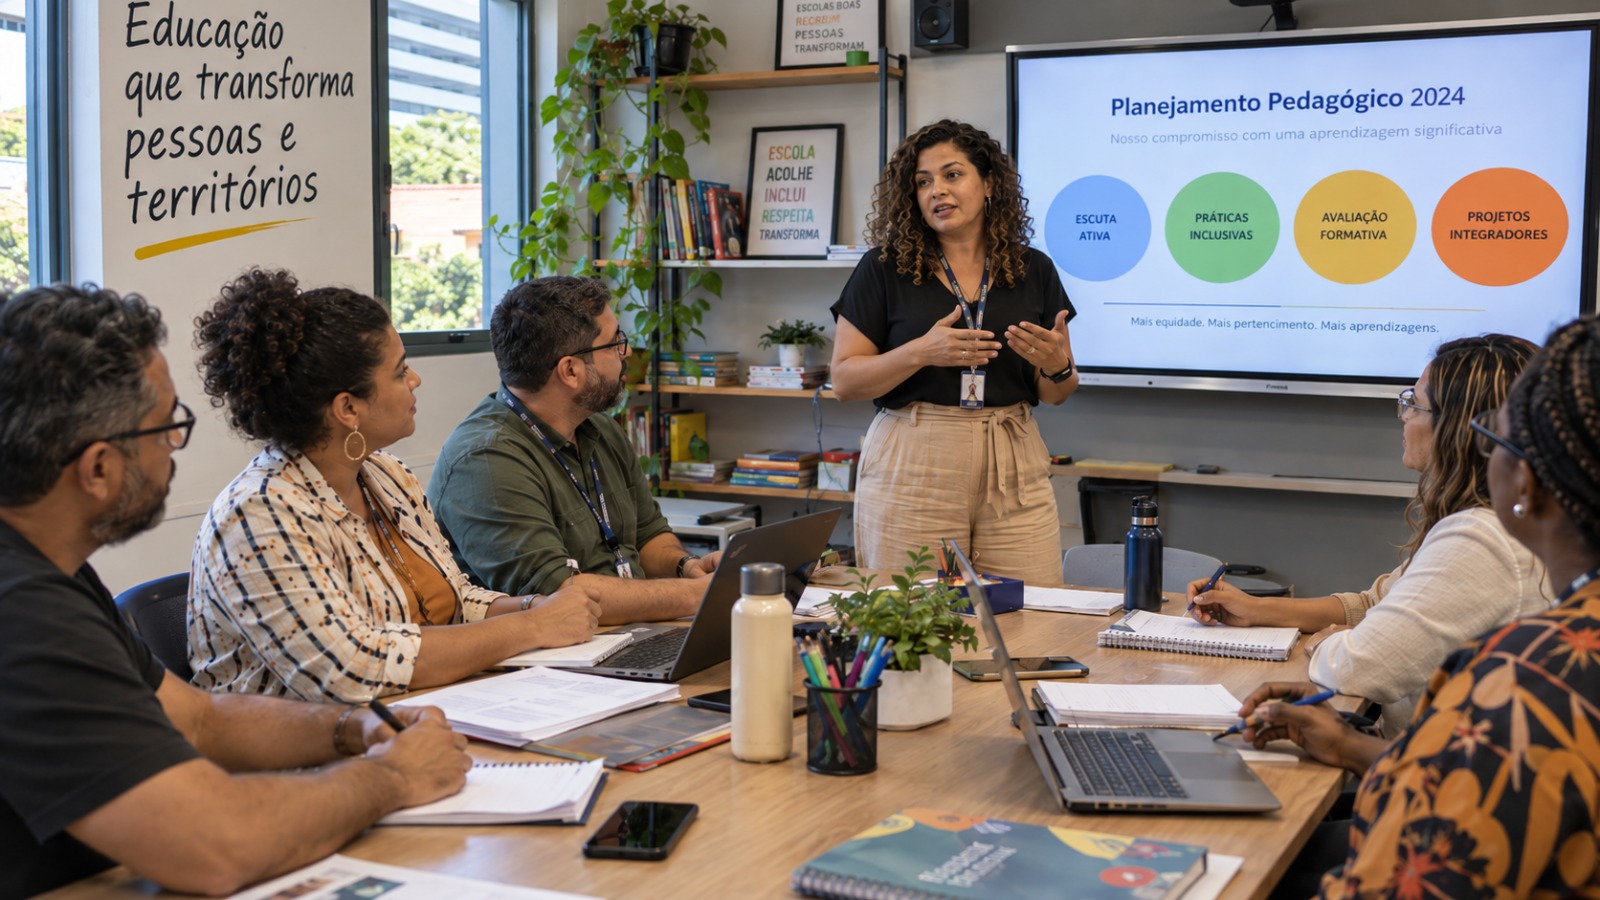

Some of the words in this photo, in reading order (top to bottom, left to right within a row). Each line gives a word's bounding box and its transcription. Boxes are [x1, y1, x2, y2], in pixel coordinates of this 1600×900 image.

[796, 2, 835, 13] ESCOLAS
[126, 1, 284, 59] Educação
[795, 28, 844, 40] PESSOAS
[794, 41, 865, 54] TRANSFORMAM
[125, 71, 182, 118] que
[196, 56, 354, 101] transforma
[1111, 96, 1261, 119] Planejamento
[1268, 88, 1403, 115] Pedagógico
[1410, 86, 1466, 107] 2024
[1110, 133, 1148, 145] Nosso
[1152, 130, 1238, 145] compromisso
[1242, 131, 1271, 141] com
[1275, 130, 1305, 140] uma
[1309, 126, 1410, 142] aprendizagem
[1414, 122, 1503, 140] significativa
[125, 122, 262, 180] pessoas
[281, 122, 296, 151] e
[768, 144, 816, 161] ESCOLA
[766, 166, 814, 182] ACOLHE
[127, 165, 318, 224] territórios
[764, 187, 806, 203] INCLUI
[762, 208, 815, 224] RESPEITA
[1075, 214, 1117, 224] ESCUTA
[1195, 210, 1249, 223] PRÁTICAS
[1321, 209, 1388, 225] AVALIAÇÃO
[1467, 211, 1530, 224] PROJETOS
[759, 228, 820, 241] TRANSFORMA
[1079, 231, 1111, 241] ATIVA
[1190, 230, 1253, 240] INCLUSIVAS
[1320, 229, 1387, 240] FORMATIVA
[1450, 229, 1548, 240] INTEGRADORES
[1130, 316, 1153, 327] Mais
[1155, 317, 1205, 329] equidade.
[1207, 318, 1232, 329] Mais
[1234, 319, 1318, 331] pertencimento.
[1320, 320, 1347, 331] Mais
[1349, 321, 1440, 335] aprendizagens.
